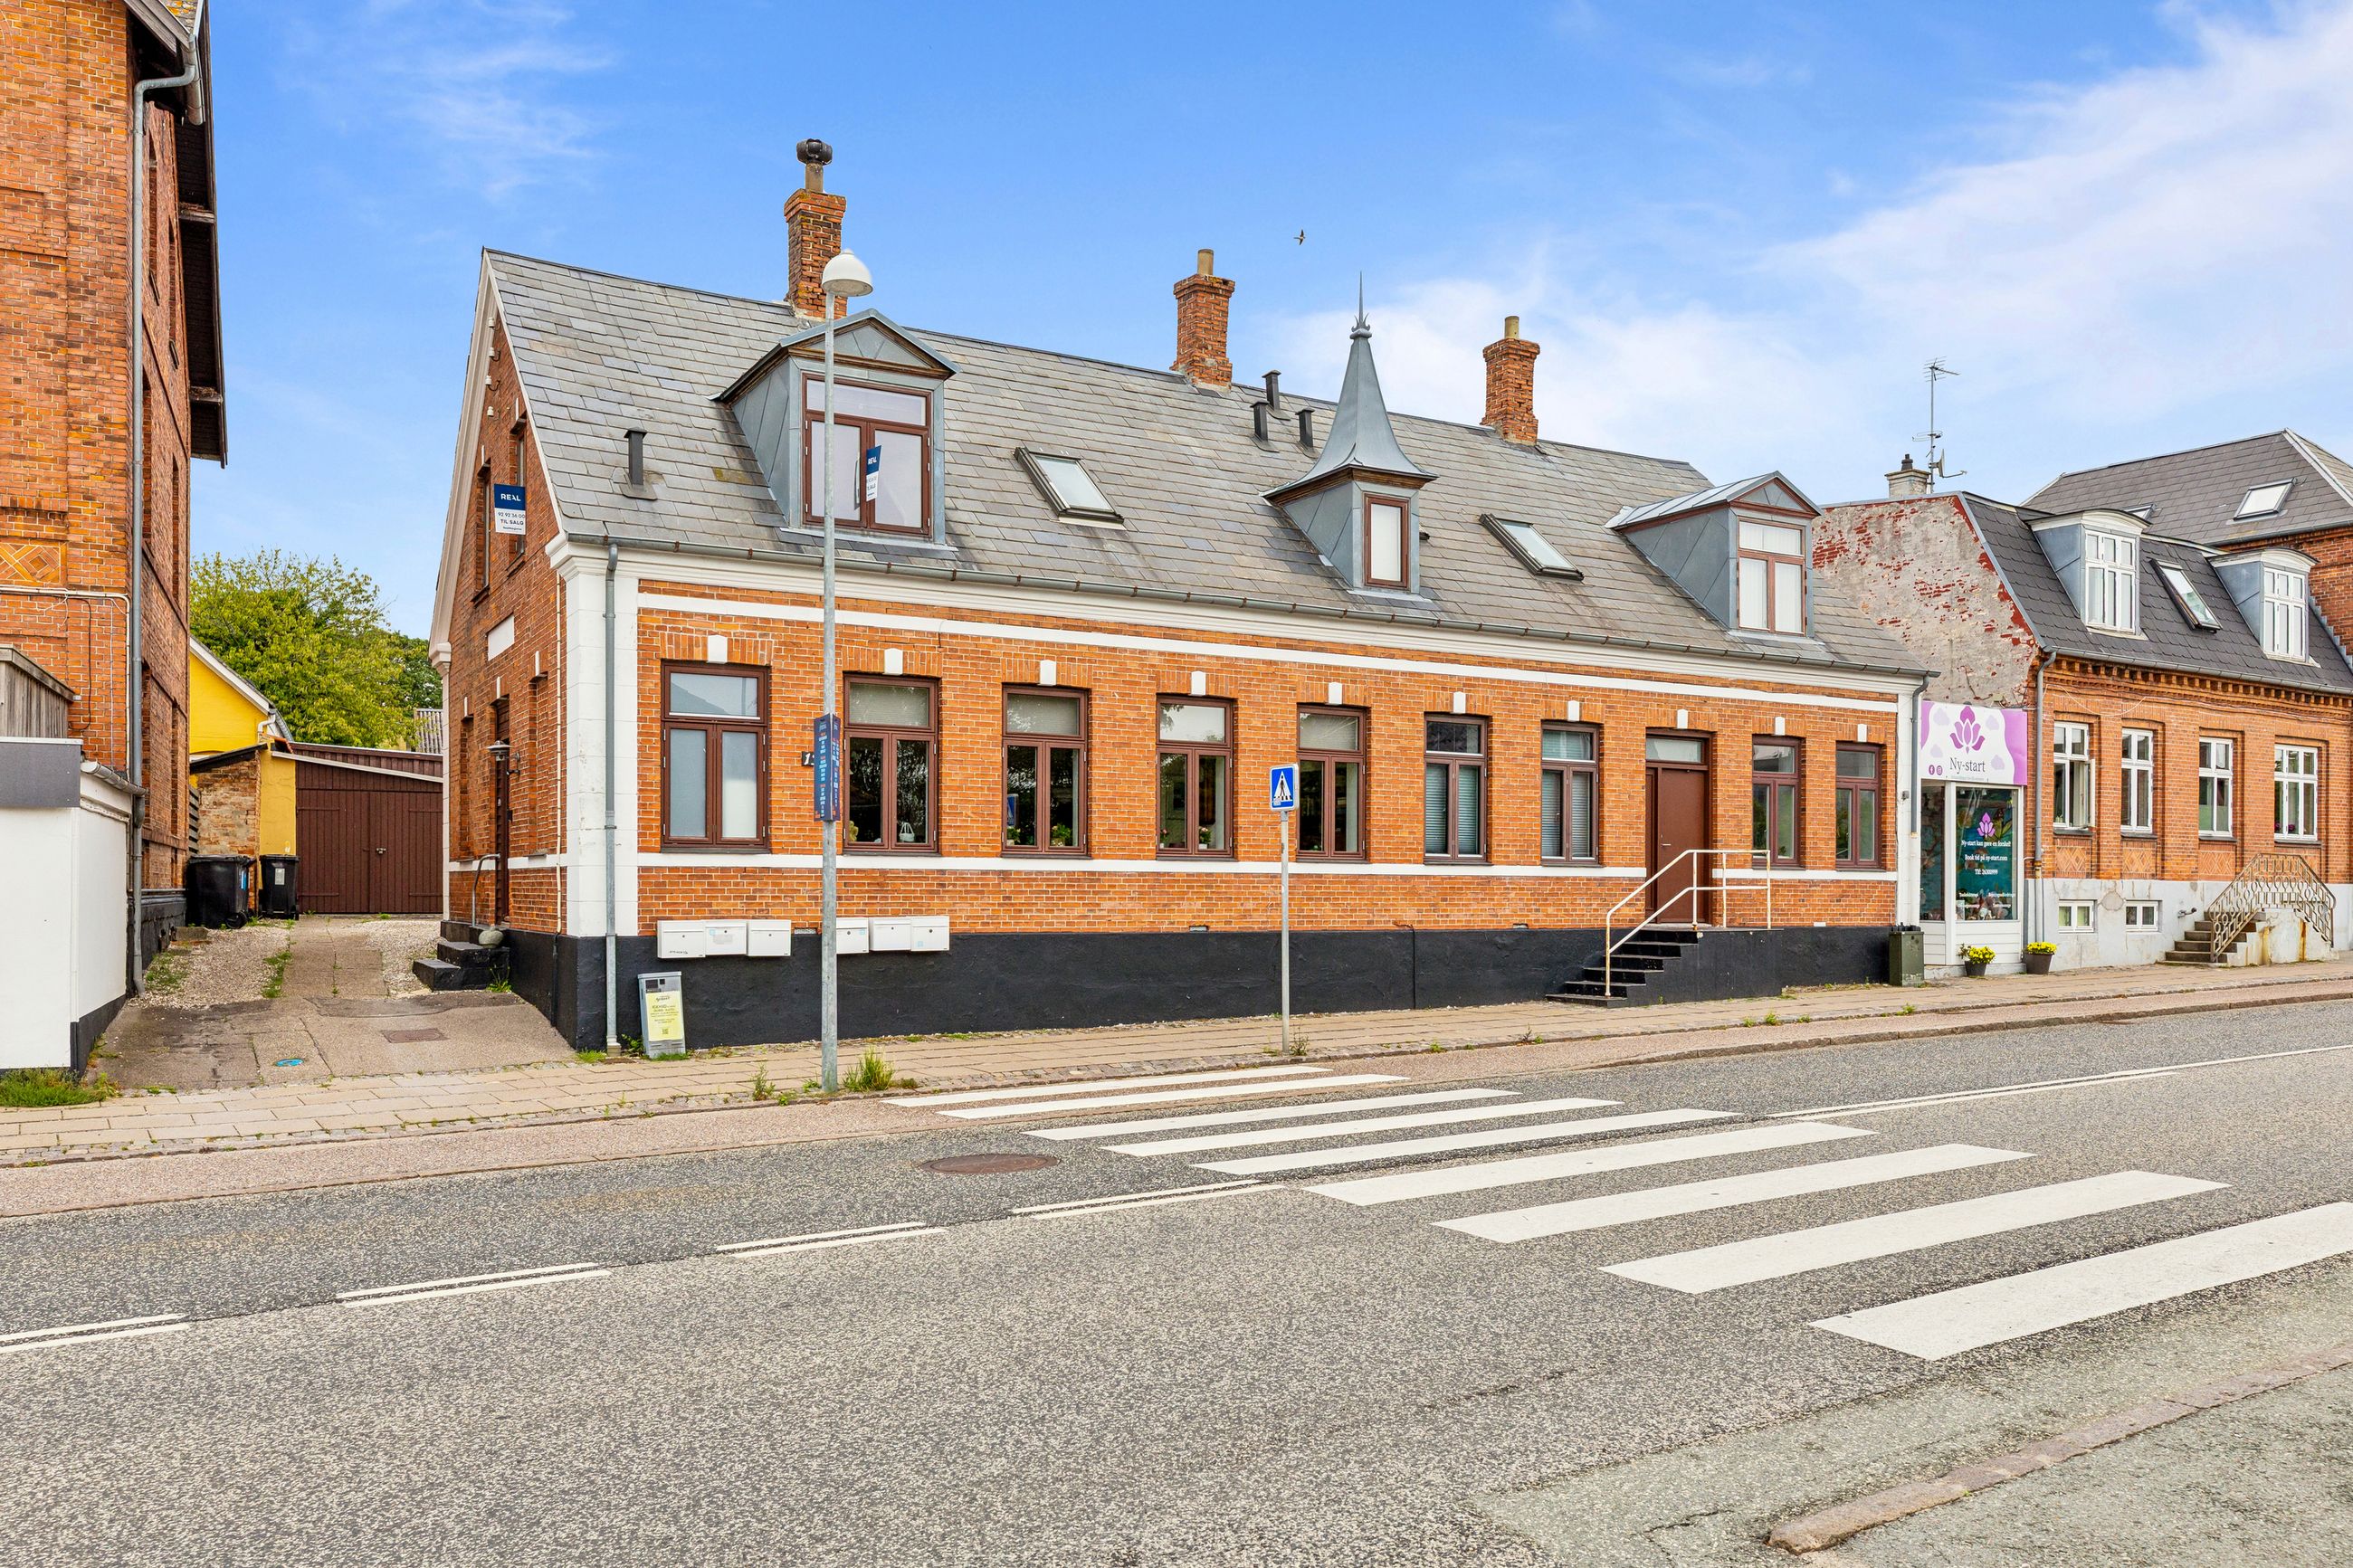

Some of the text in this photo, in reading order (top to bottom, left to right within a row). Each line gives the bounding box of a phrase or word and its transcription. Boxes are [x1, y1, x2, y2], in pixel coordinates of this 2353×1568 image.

[500, 493, 521, 501] REAL
[804, 753, 814, 765] 1
[1949, 757, 1986, 774] Ny-start
